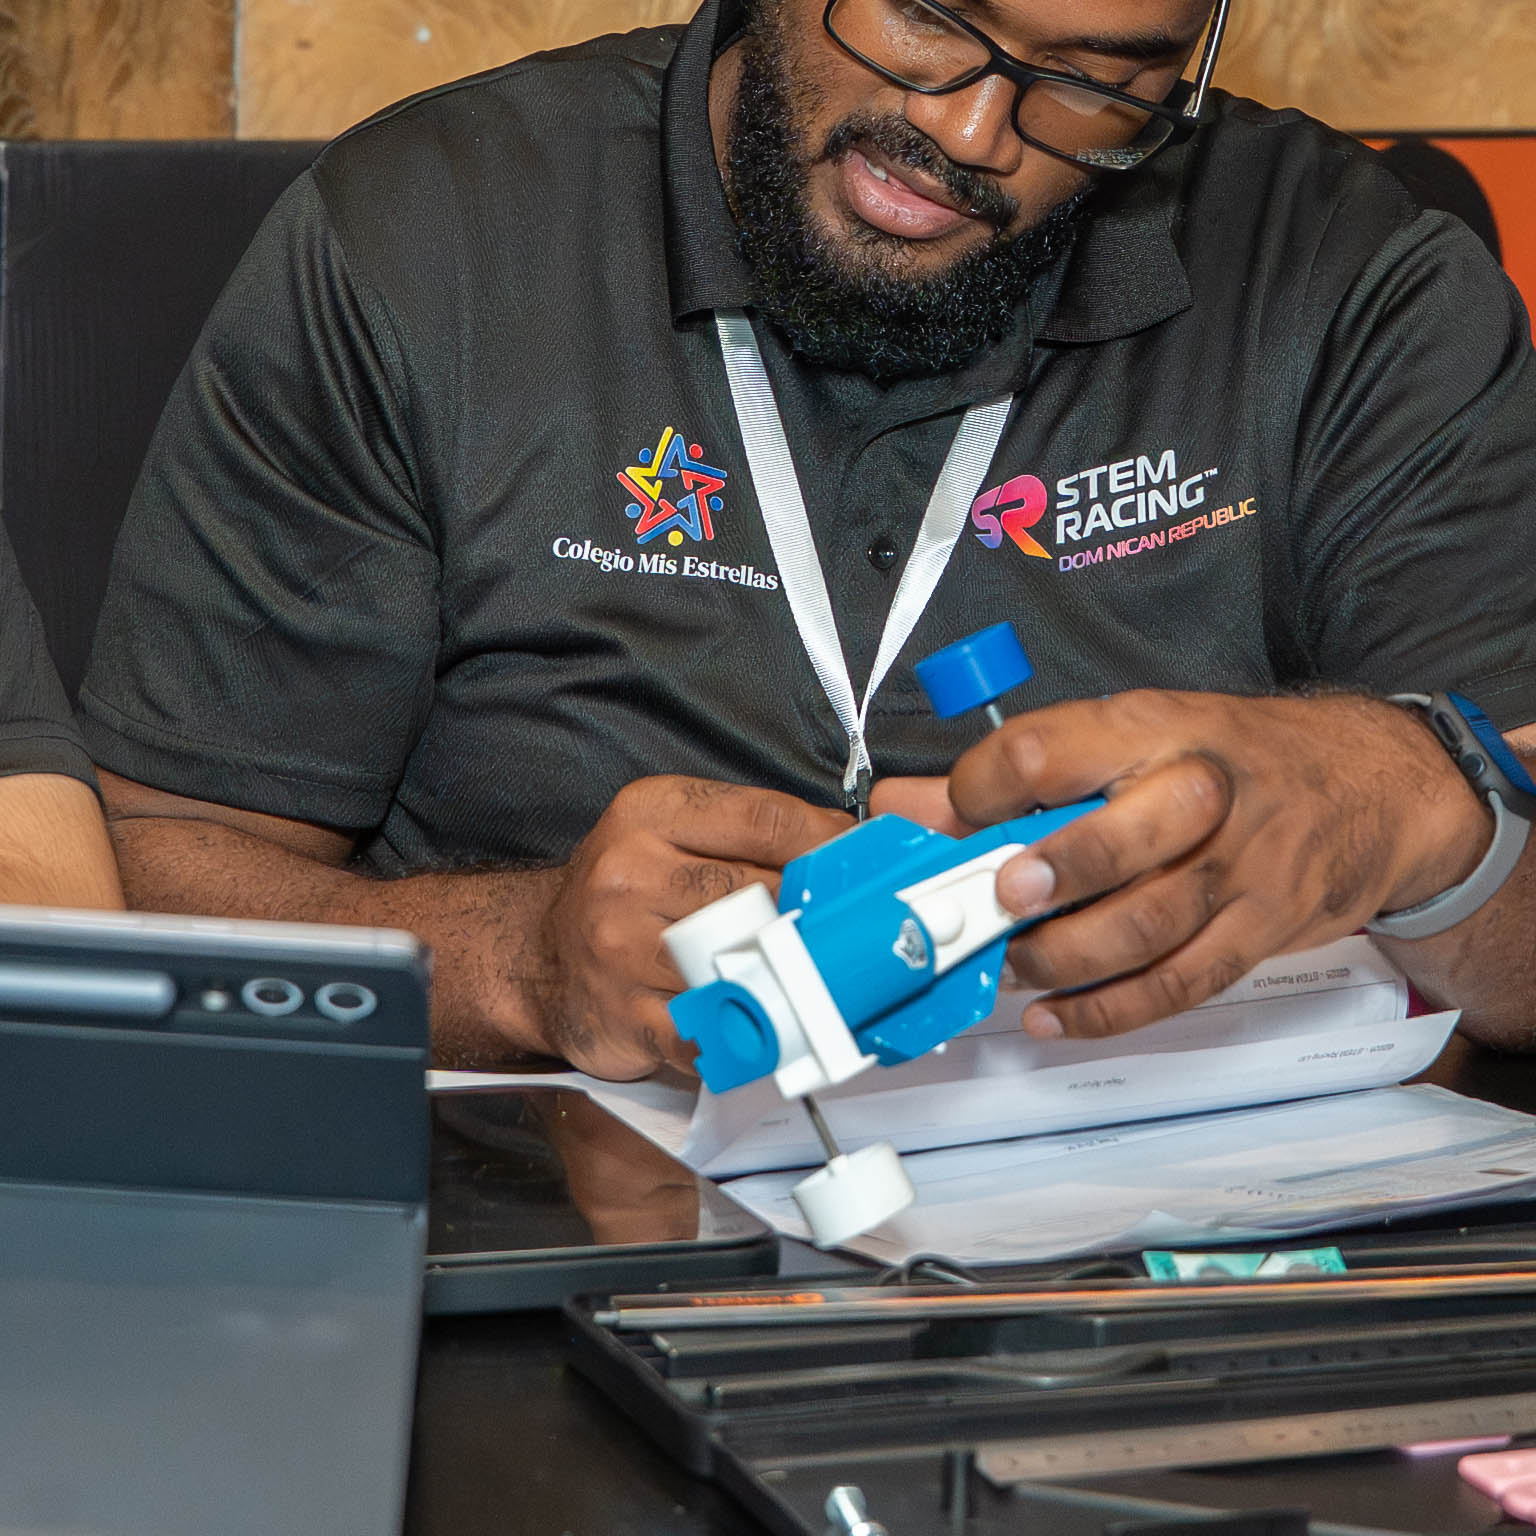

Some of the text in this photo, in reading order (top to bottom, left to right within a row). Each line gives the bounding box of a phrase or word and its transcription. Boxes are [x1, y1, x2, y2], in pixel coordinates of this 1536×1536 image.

[1056, 449, 1177, 510] STEM
[552, 537, 779, 590] Colegio Mis Estrellas
[1058, 496, 1257, 573] DOMNICAN REPUBLIC
